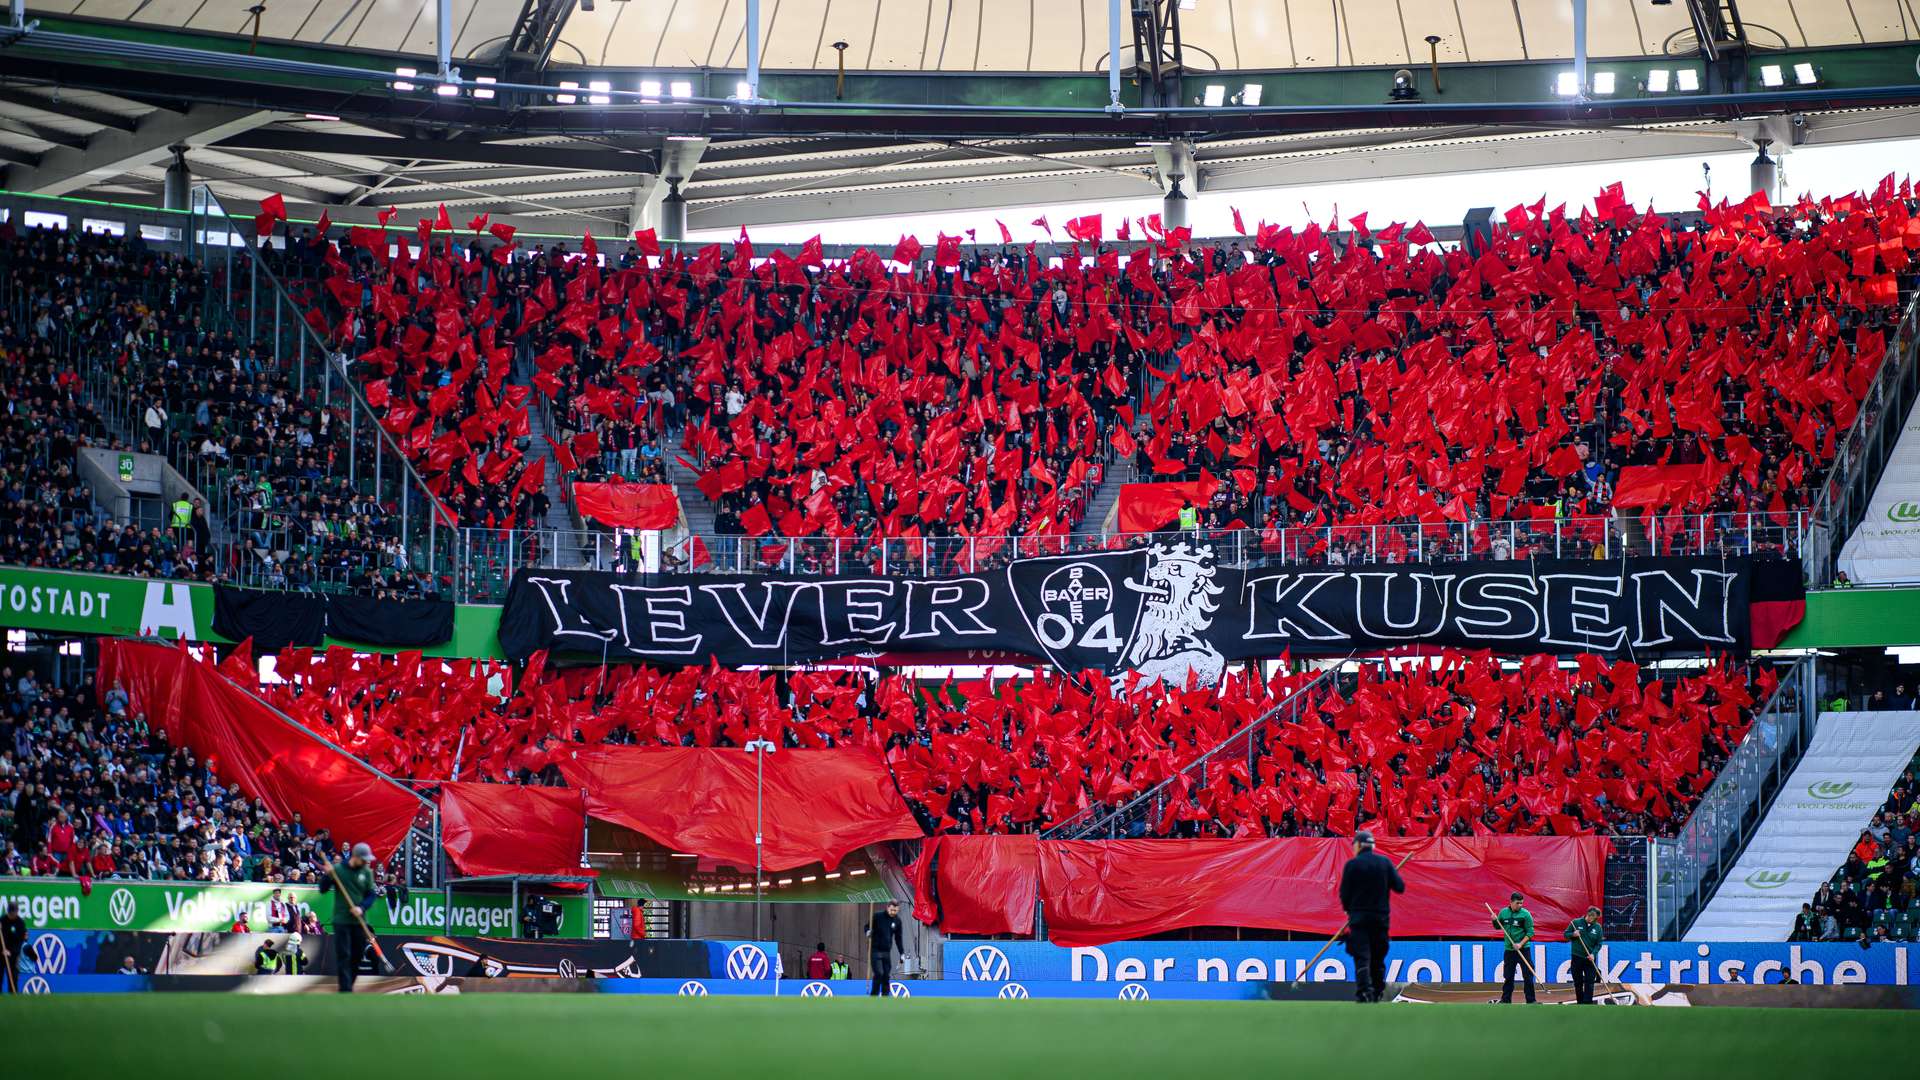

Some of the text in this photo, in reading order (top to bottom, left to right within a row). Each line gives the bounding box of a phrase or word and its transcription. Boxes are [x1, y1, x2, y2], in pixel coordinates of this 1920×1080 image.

[527, 569, 1738, 655] LEVER KUSEN
[1044, 587, 1109, 602] BAYER
[1067, 567, 1085, 625] BAYER
[1037, 612, 1123, 653] 04
[1071, 946, 1176, 982] Der
[1197, 957, 1346, 982] neue
